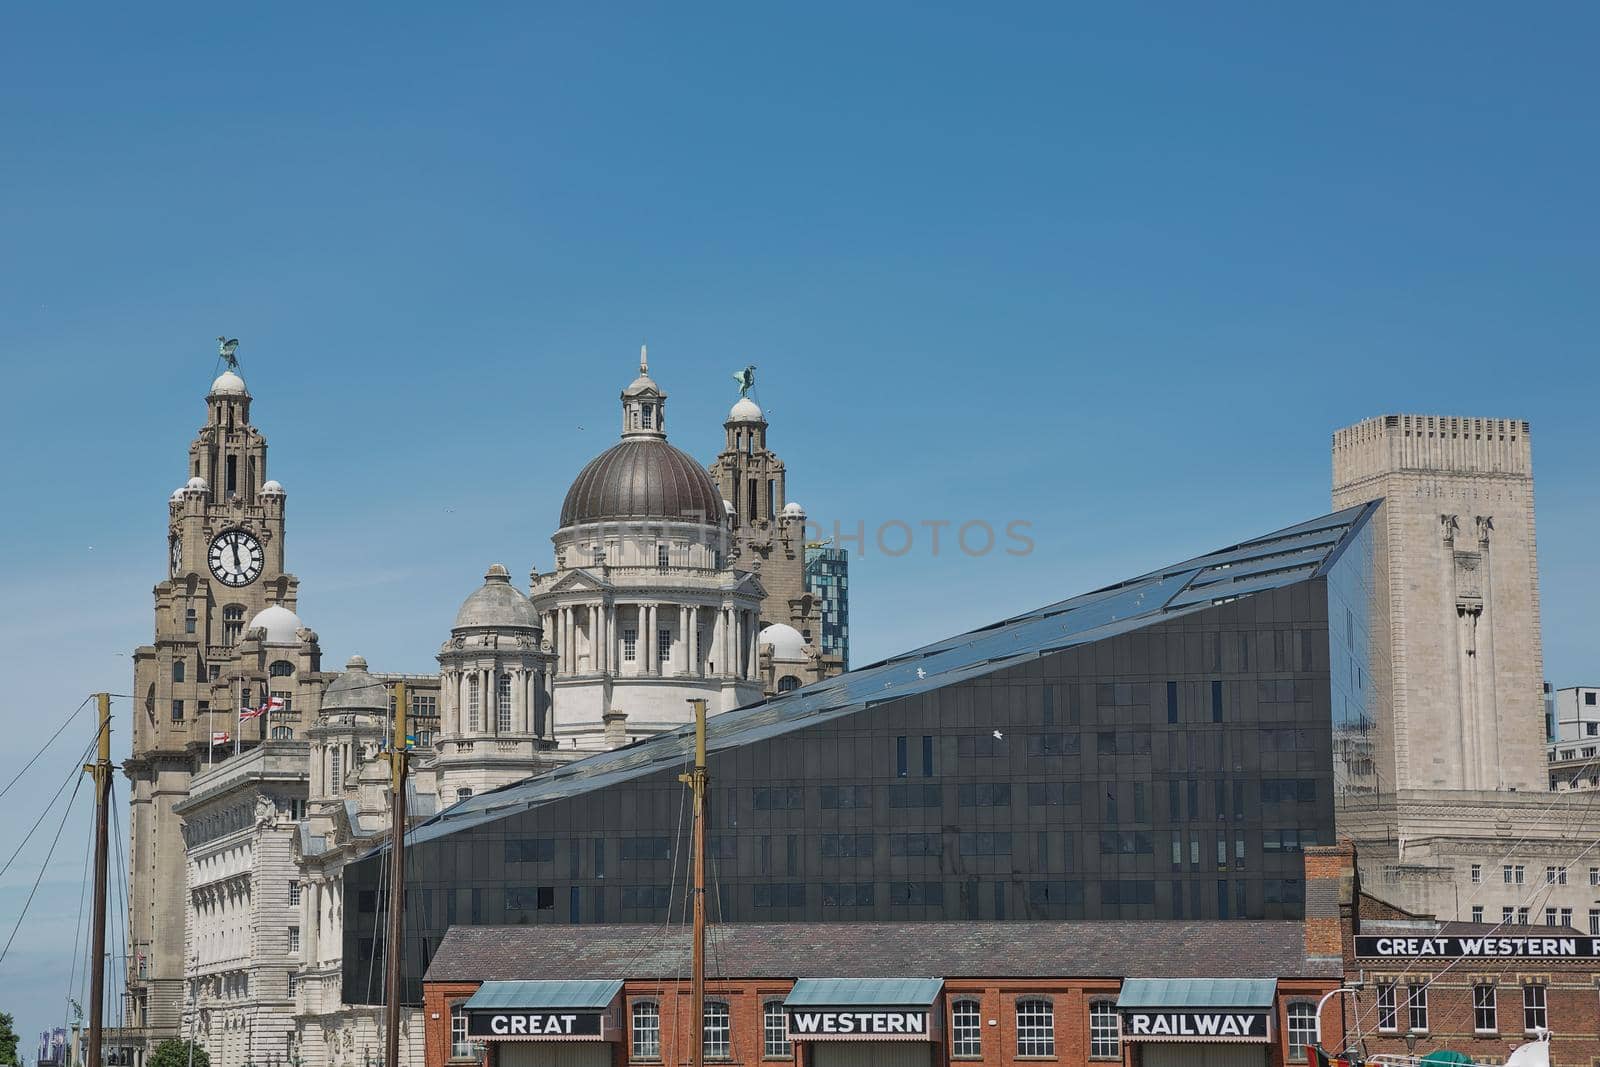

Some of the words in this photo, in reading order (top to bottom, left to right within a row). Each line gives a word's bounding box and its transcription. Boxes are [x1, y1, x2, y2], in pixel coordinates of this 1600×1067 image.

[1376, 938, 1448, 955] GREAT
[1458, 938, 1576, 955] WESTERN
[490, 1015, 577, 1034] GREAT
[794, 1013, 923, 1032] WESTERN
[1132, 1014, 1255, 1035] RAILWAY
